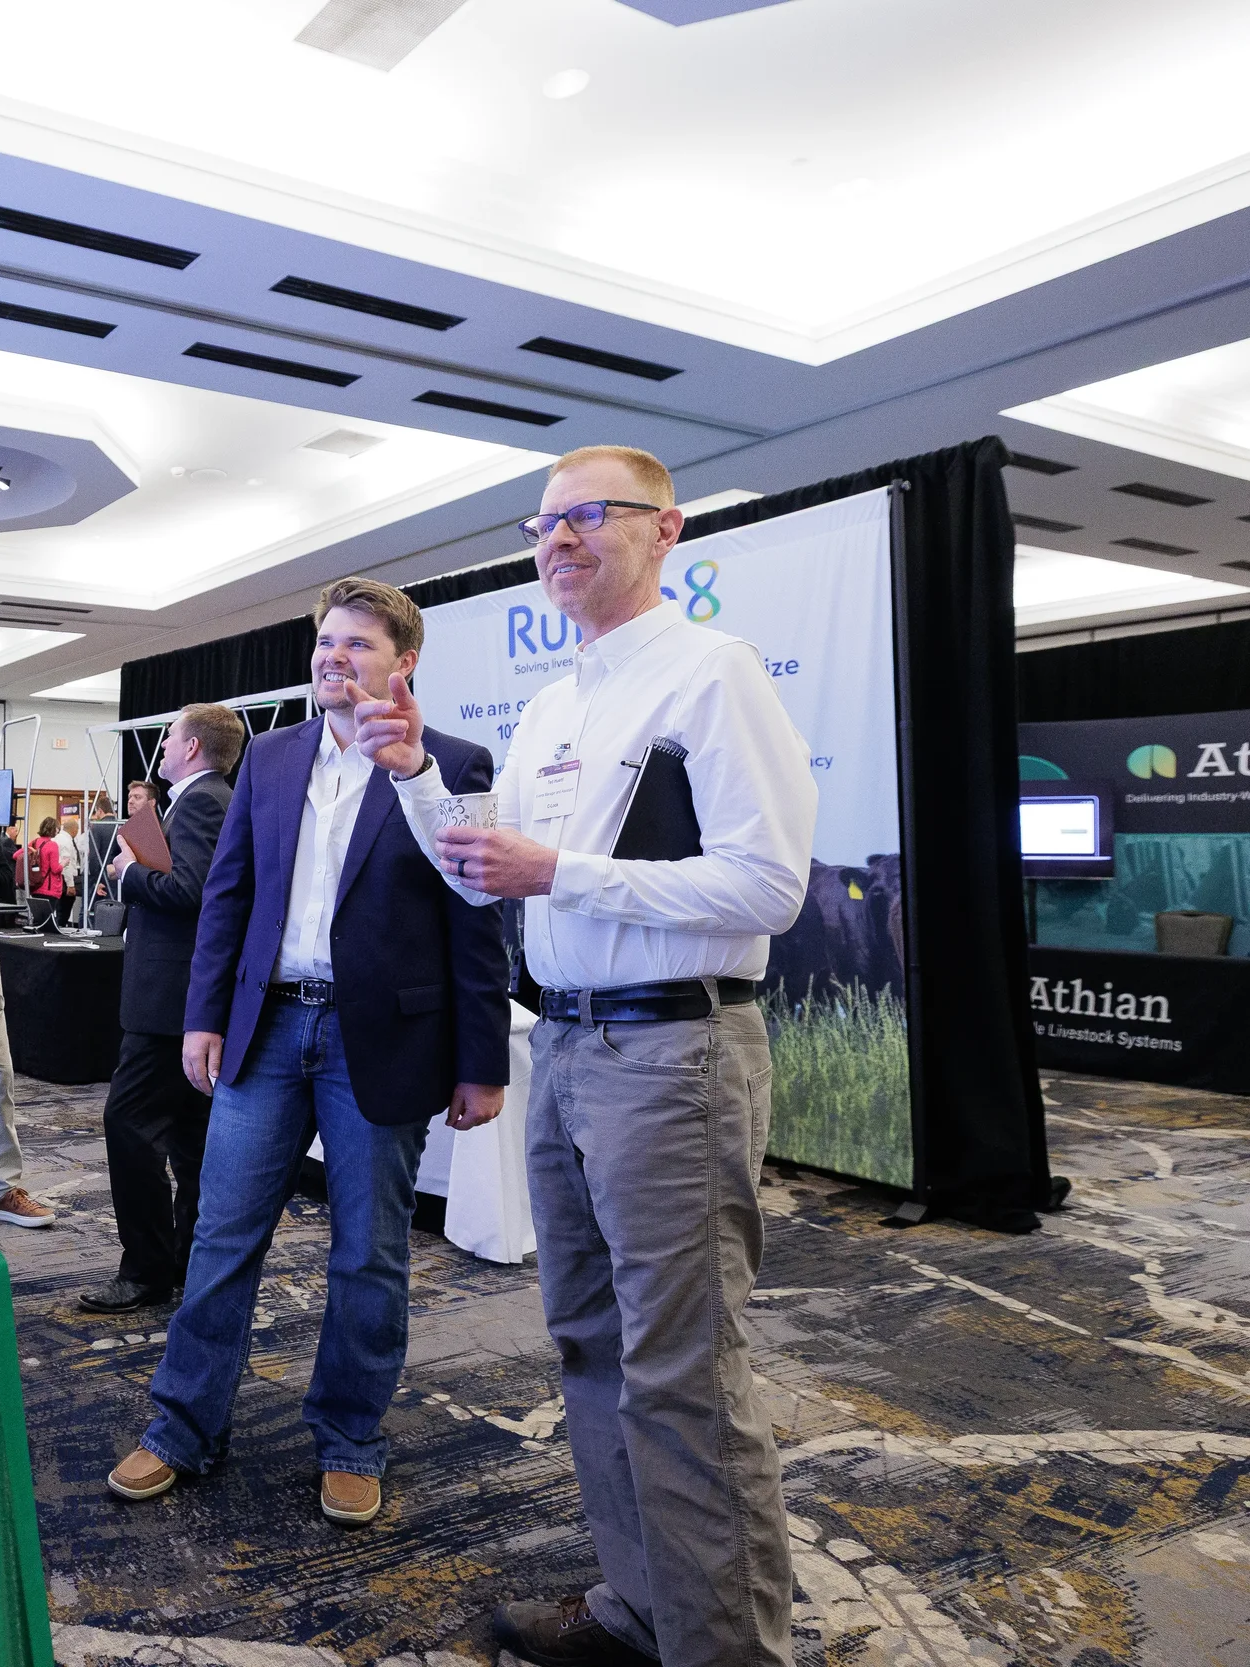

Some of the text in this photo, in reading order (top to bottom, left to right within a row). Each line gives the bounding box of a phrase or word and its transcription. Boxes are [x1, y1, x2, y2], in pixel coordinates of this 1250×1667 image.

[514, 661, 549, 675] Solving
[460, 699, 531, 720] We are o
[1125, 793, 1185, 804] Delivering
[1029, 976, 1172, 1023] Athian
[1048, 1023, 1114, 1044] Livestock
[1116, 1031, 1183, 1052] Systems
